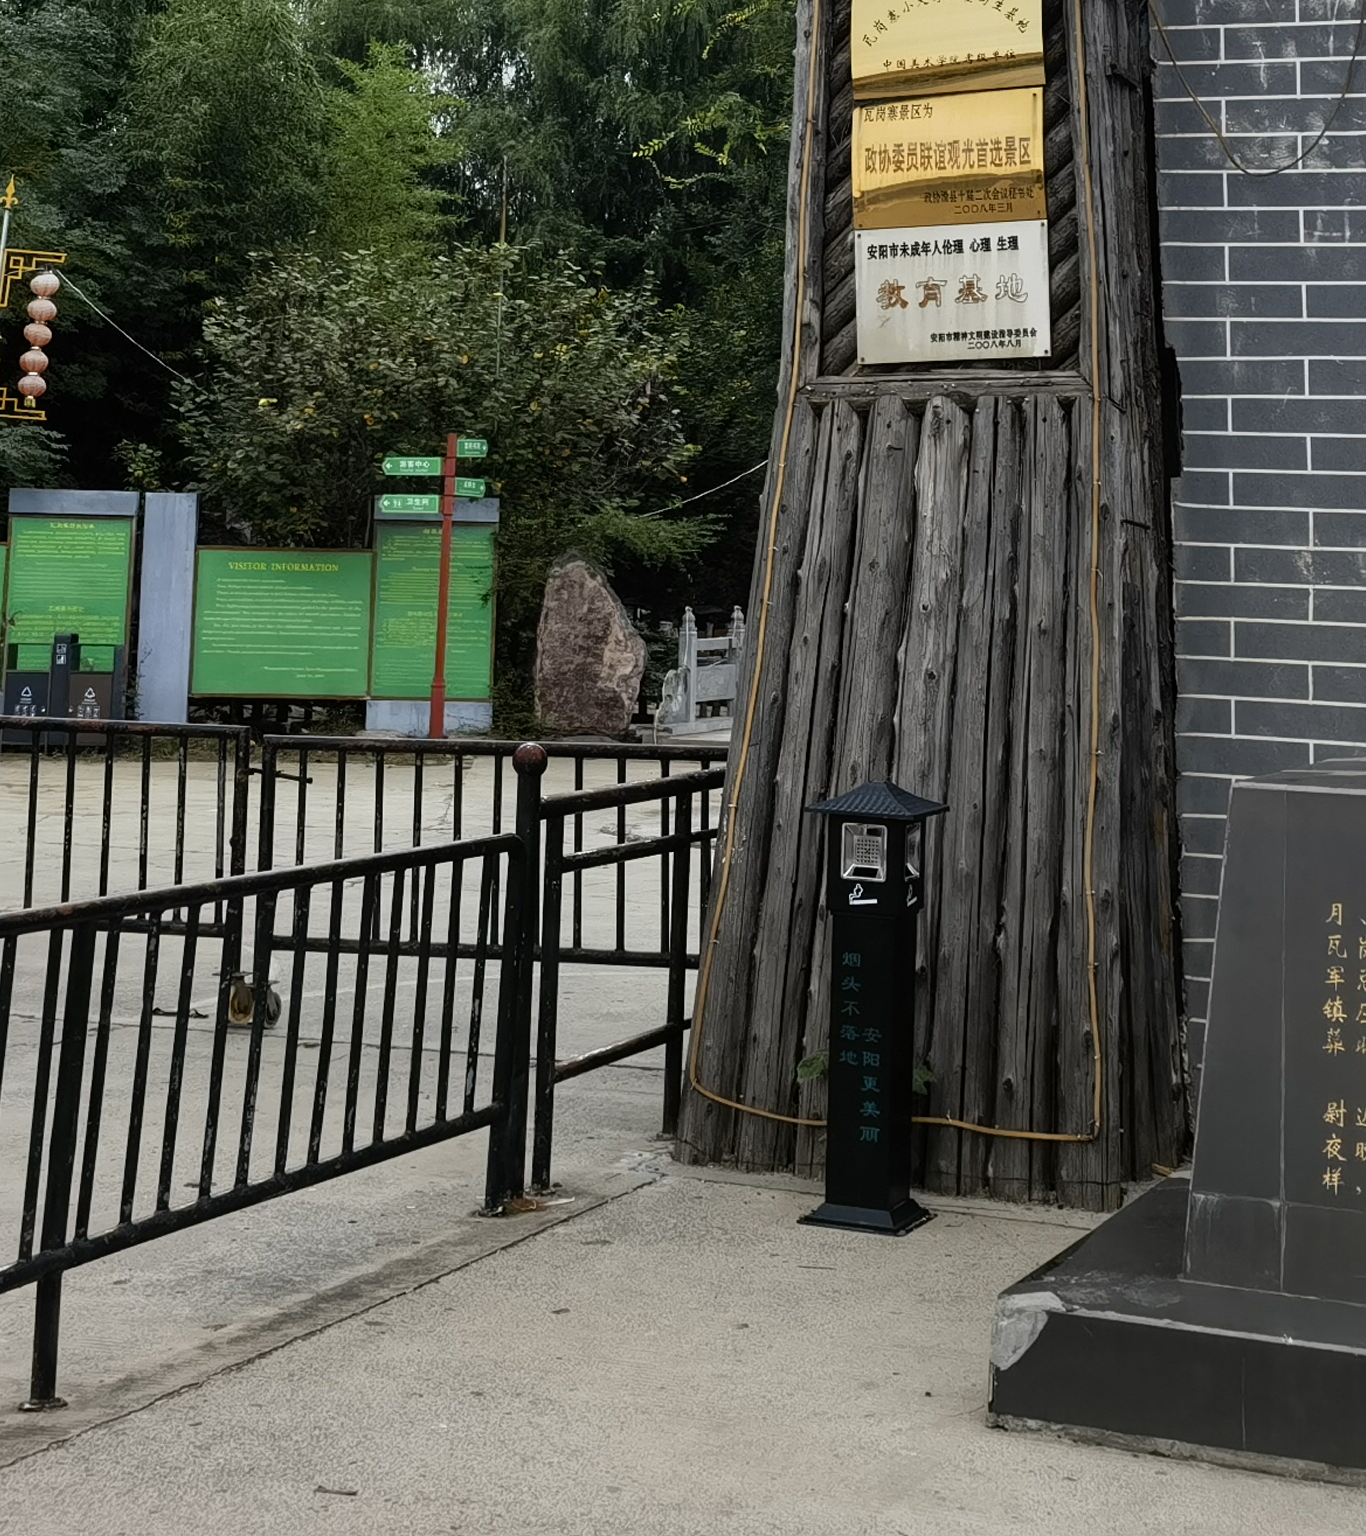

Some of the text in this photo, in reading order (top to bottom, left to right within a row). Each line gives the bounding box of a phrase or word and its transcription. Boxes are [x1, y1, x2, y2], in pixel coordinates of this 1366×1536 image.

[863, 102, 933, 123] 瓦岗寨景区为
[864, 135, 1032, 174] 政协委员联谊观光首选景区
[866, 235, 1020, 260] 安阳市未成年人伦理 心理 生理
[875, 272, 1029, 311] 教育基地
[228, 561, 339, 572] VISITOR INFORMATION
[839, 951, 861, 1066] 烟头不落地
[859, 1027, 882, 1143] 安阳更美丽
